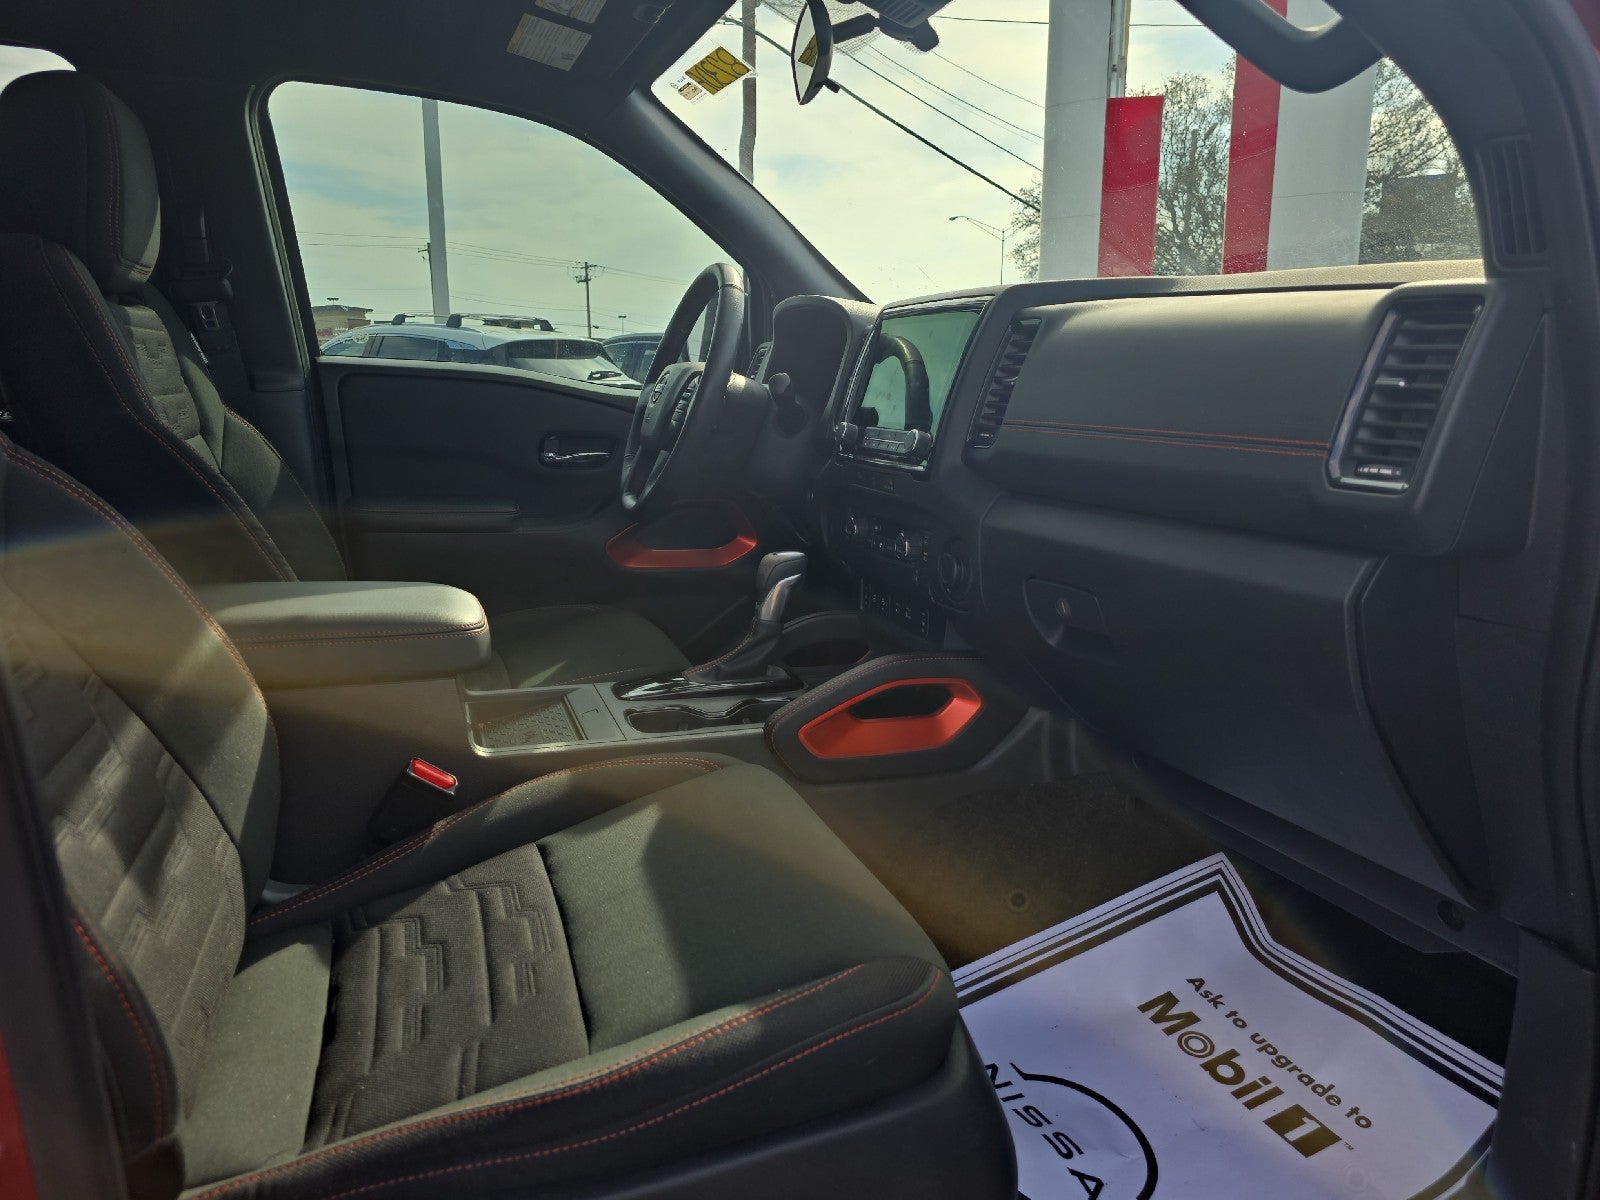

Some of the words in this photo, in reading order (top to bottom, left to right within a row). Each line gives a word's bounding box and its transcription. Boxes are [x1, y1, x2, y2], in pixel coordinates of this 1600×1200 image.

[1136, 990, 1285, 1111] Mobil
[1185, 977, 1225, 1010] Ask
[1225, 1010, 1248, 1029] to
[1249, 1032, 1342, 1106] upgrade
[1345, 1106, 1372, 1129] to
